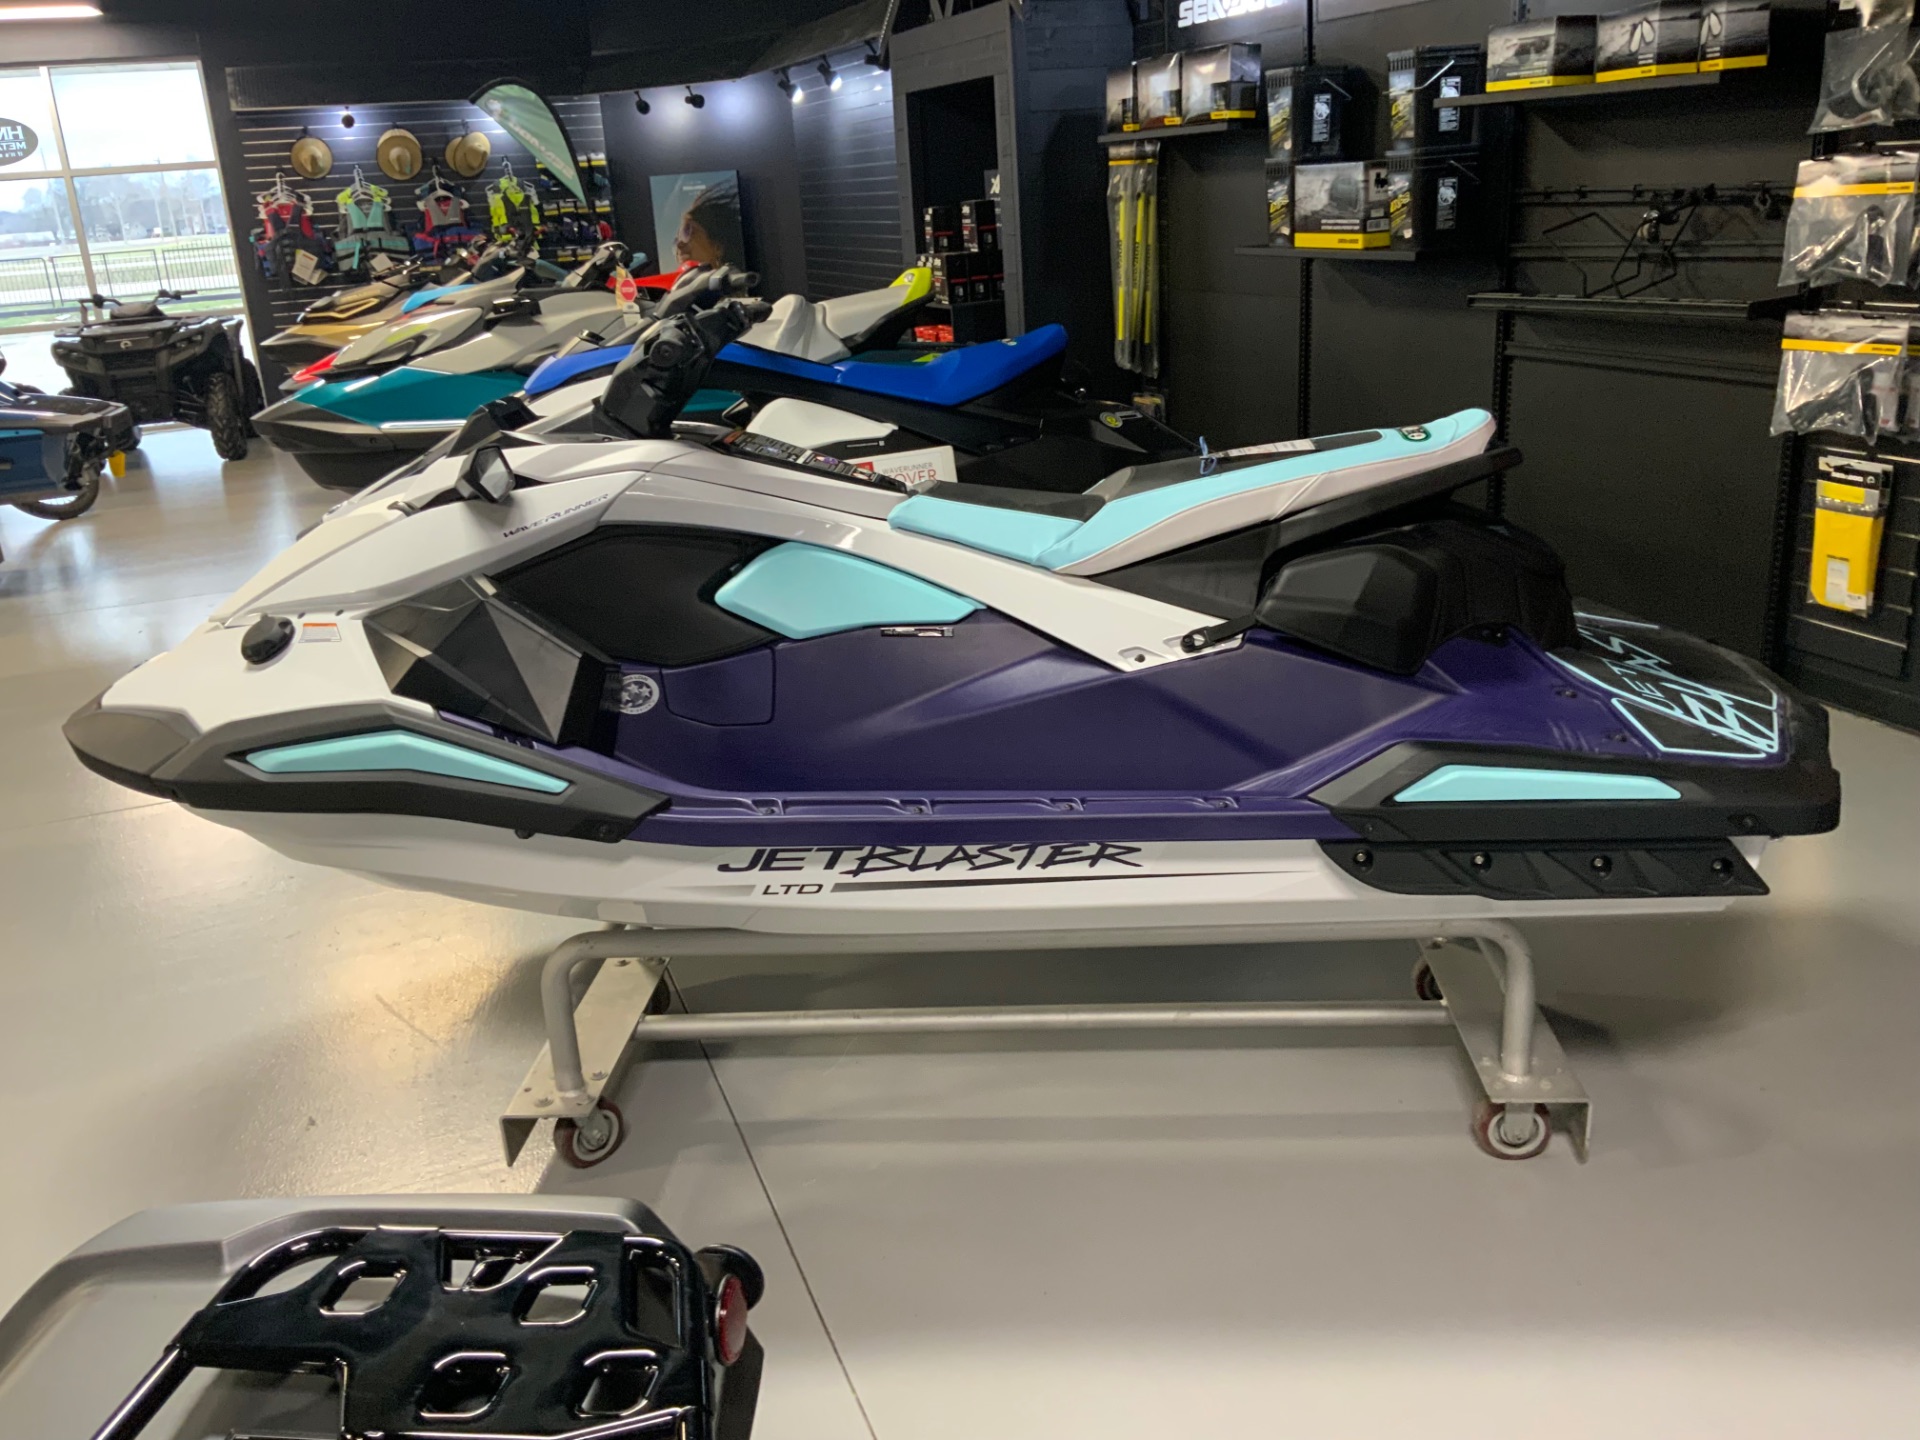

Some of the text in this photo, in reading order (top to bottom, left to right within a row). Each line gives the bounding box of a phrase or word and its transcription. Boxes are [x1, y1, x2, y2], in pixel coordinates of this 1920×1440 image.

[888, 468, 937, 485] OVER
[503, 493, 609, 538] WAVERUNNER
[761, 882, 824, 896] LTD
